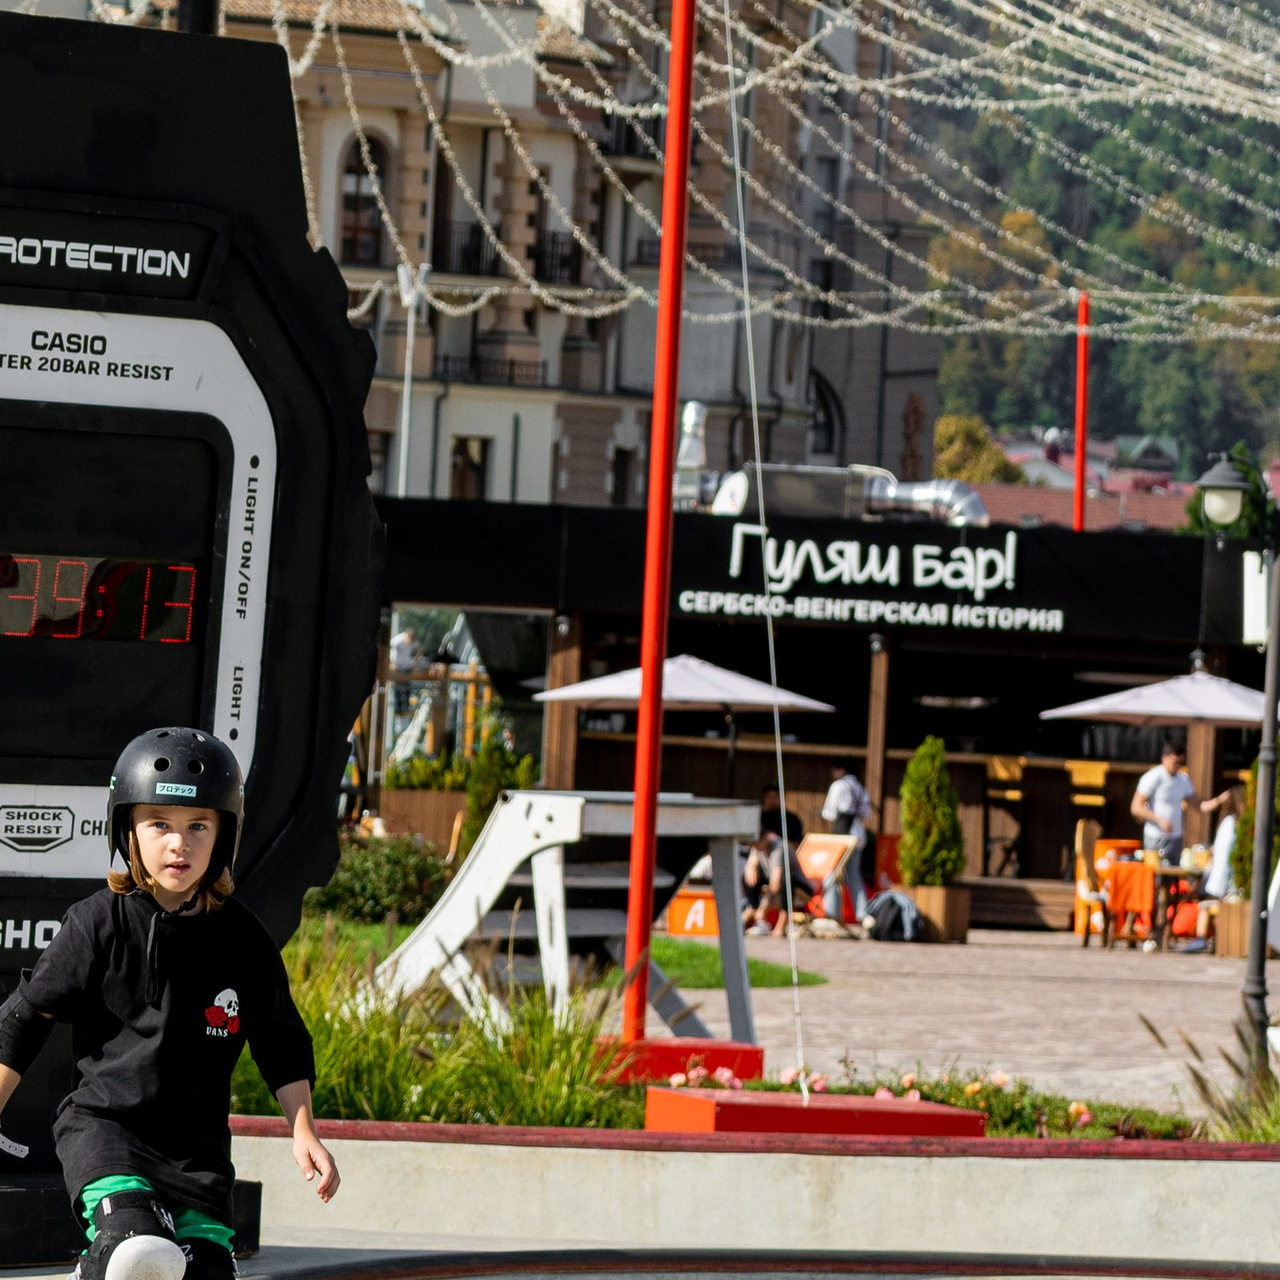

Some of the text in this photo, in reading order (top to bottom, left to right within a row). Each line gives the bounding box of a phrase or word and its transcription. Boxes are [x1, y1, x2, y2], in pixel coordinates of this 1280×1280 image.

[30, 330, 108, 356] CASIO
[37, 356, 100, 376] 20BAR
[106, 362, 174, 381] RESIST
[236, 477, 258, 620] LIGHT ON/OFF
[728, 522, 901, 594] Гуляш
[678, 589, 1064, 632] СЕРБСКО-ВЕНГЕРСКАЯ ИСТОРИЯ
[230, 666, 244, 721] LIGHT
[4, 825, 63, 834] RESIST
[5, 811, 63, 821] SHOCK
